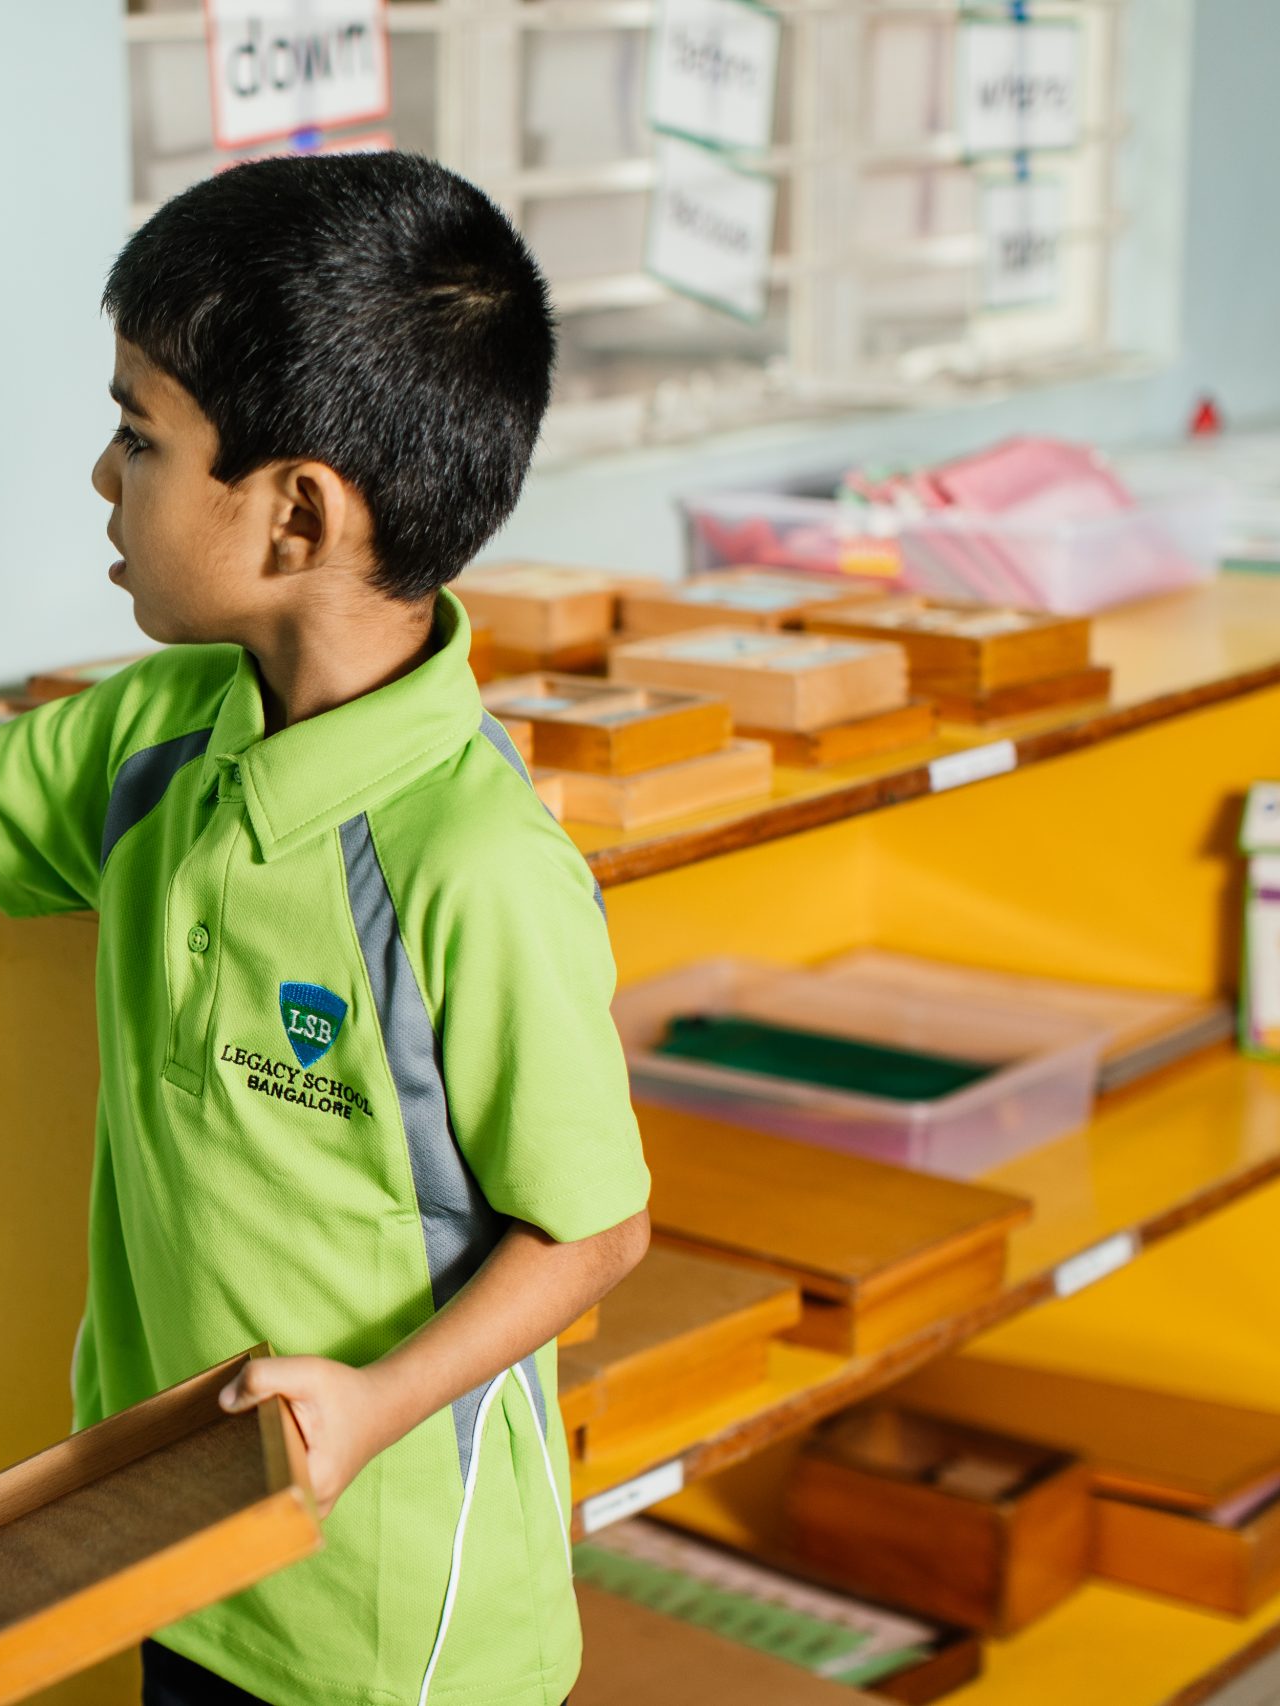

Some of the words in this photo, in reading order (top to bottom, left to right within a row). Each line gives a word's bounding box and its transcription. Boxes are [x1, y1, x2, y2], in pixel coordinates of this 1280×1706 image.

[225, 18, 374, 97] down
[288, 1009, 331, 1044] LSB
[221, 1045, 300, 1085] LEGACY
[303, 1073, 373, 1117] SCHOOL
[247, 1075, 352, 1120] BANGALORE
